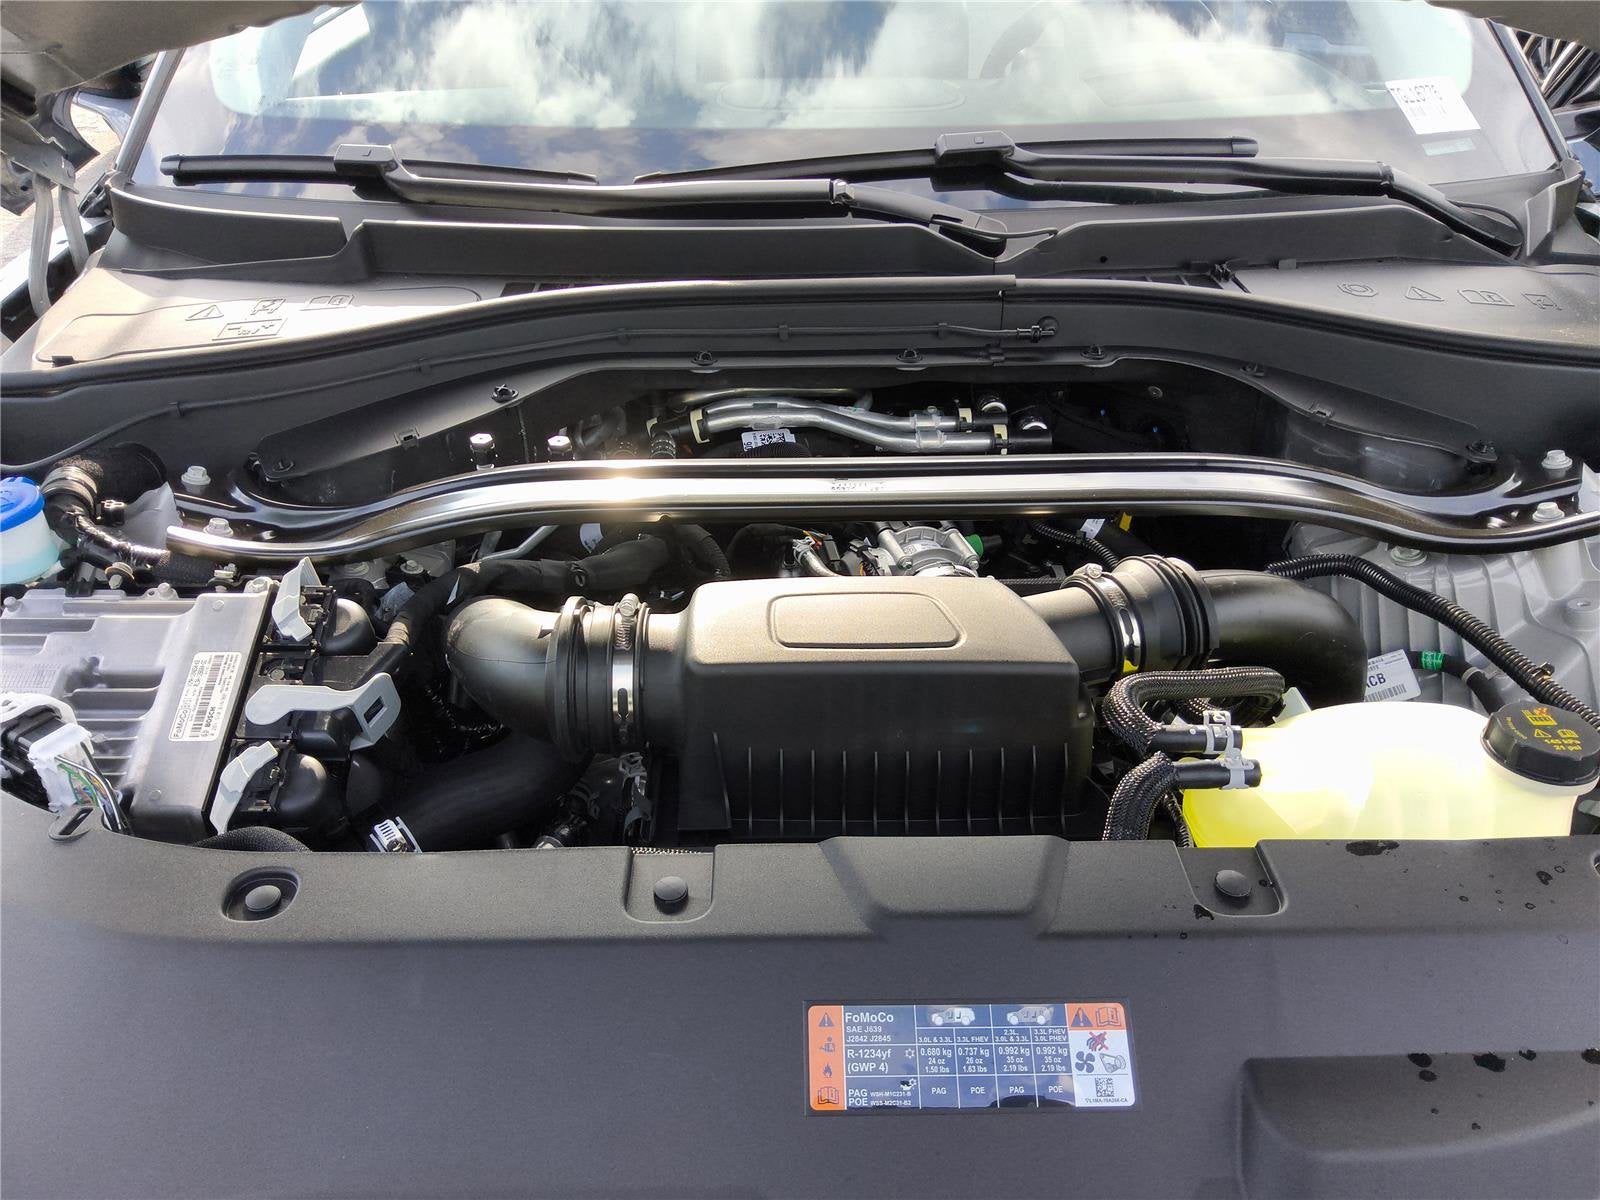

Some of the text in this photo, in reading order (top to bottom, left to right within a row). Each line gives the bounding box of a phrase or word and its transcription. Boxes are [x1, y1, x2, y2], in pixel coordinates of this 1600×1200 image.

[1367, 673, 1386, 688] CB
[205, 706, 216, 728] BOSCH
[173, 709, 188, 738] FoMoCo
[845, 1012, 894, 1023] FoMoCo
[846, 1035, 868, 1043] J2842
[847, 1048, 892, 1060] R-1234yf
[920, 1048, 952, 1057] 0.680 kg
[958, 1047, 989, 1057] 0.737 kg
[998, 1047, 1030, 1056] 0.992 kg
[1036, 1047, 1067, 1056] 0.992 kg
[848, 1062, 889, 1074] (GWP 4)
[848, 1089, 868, 1097] PAG
[1009, 1086, 1024, 1094] PAG
[848, 1098, 868, 1106] POE
